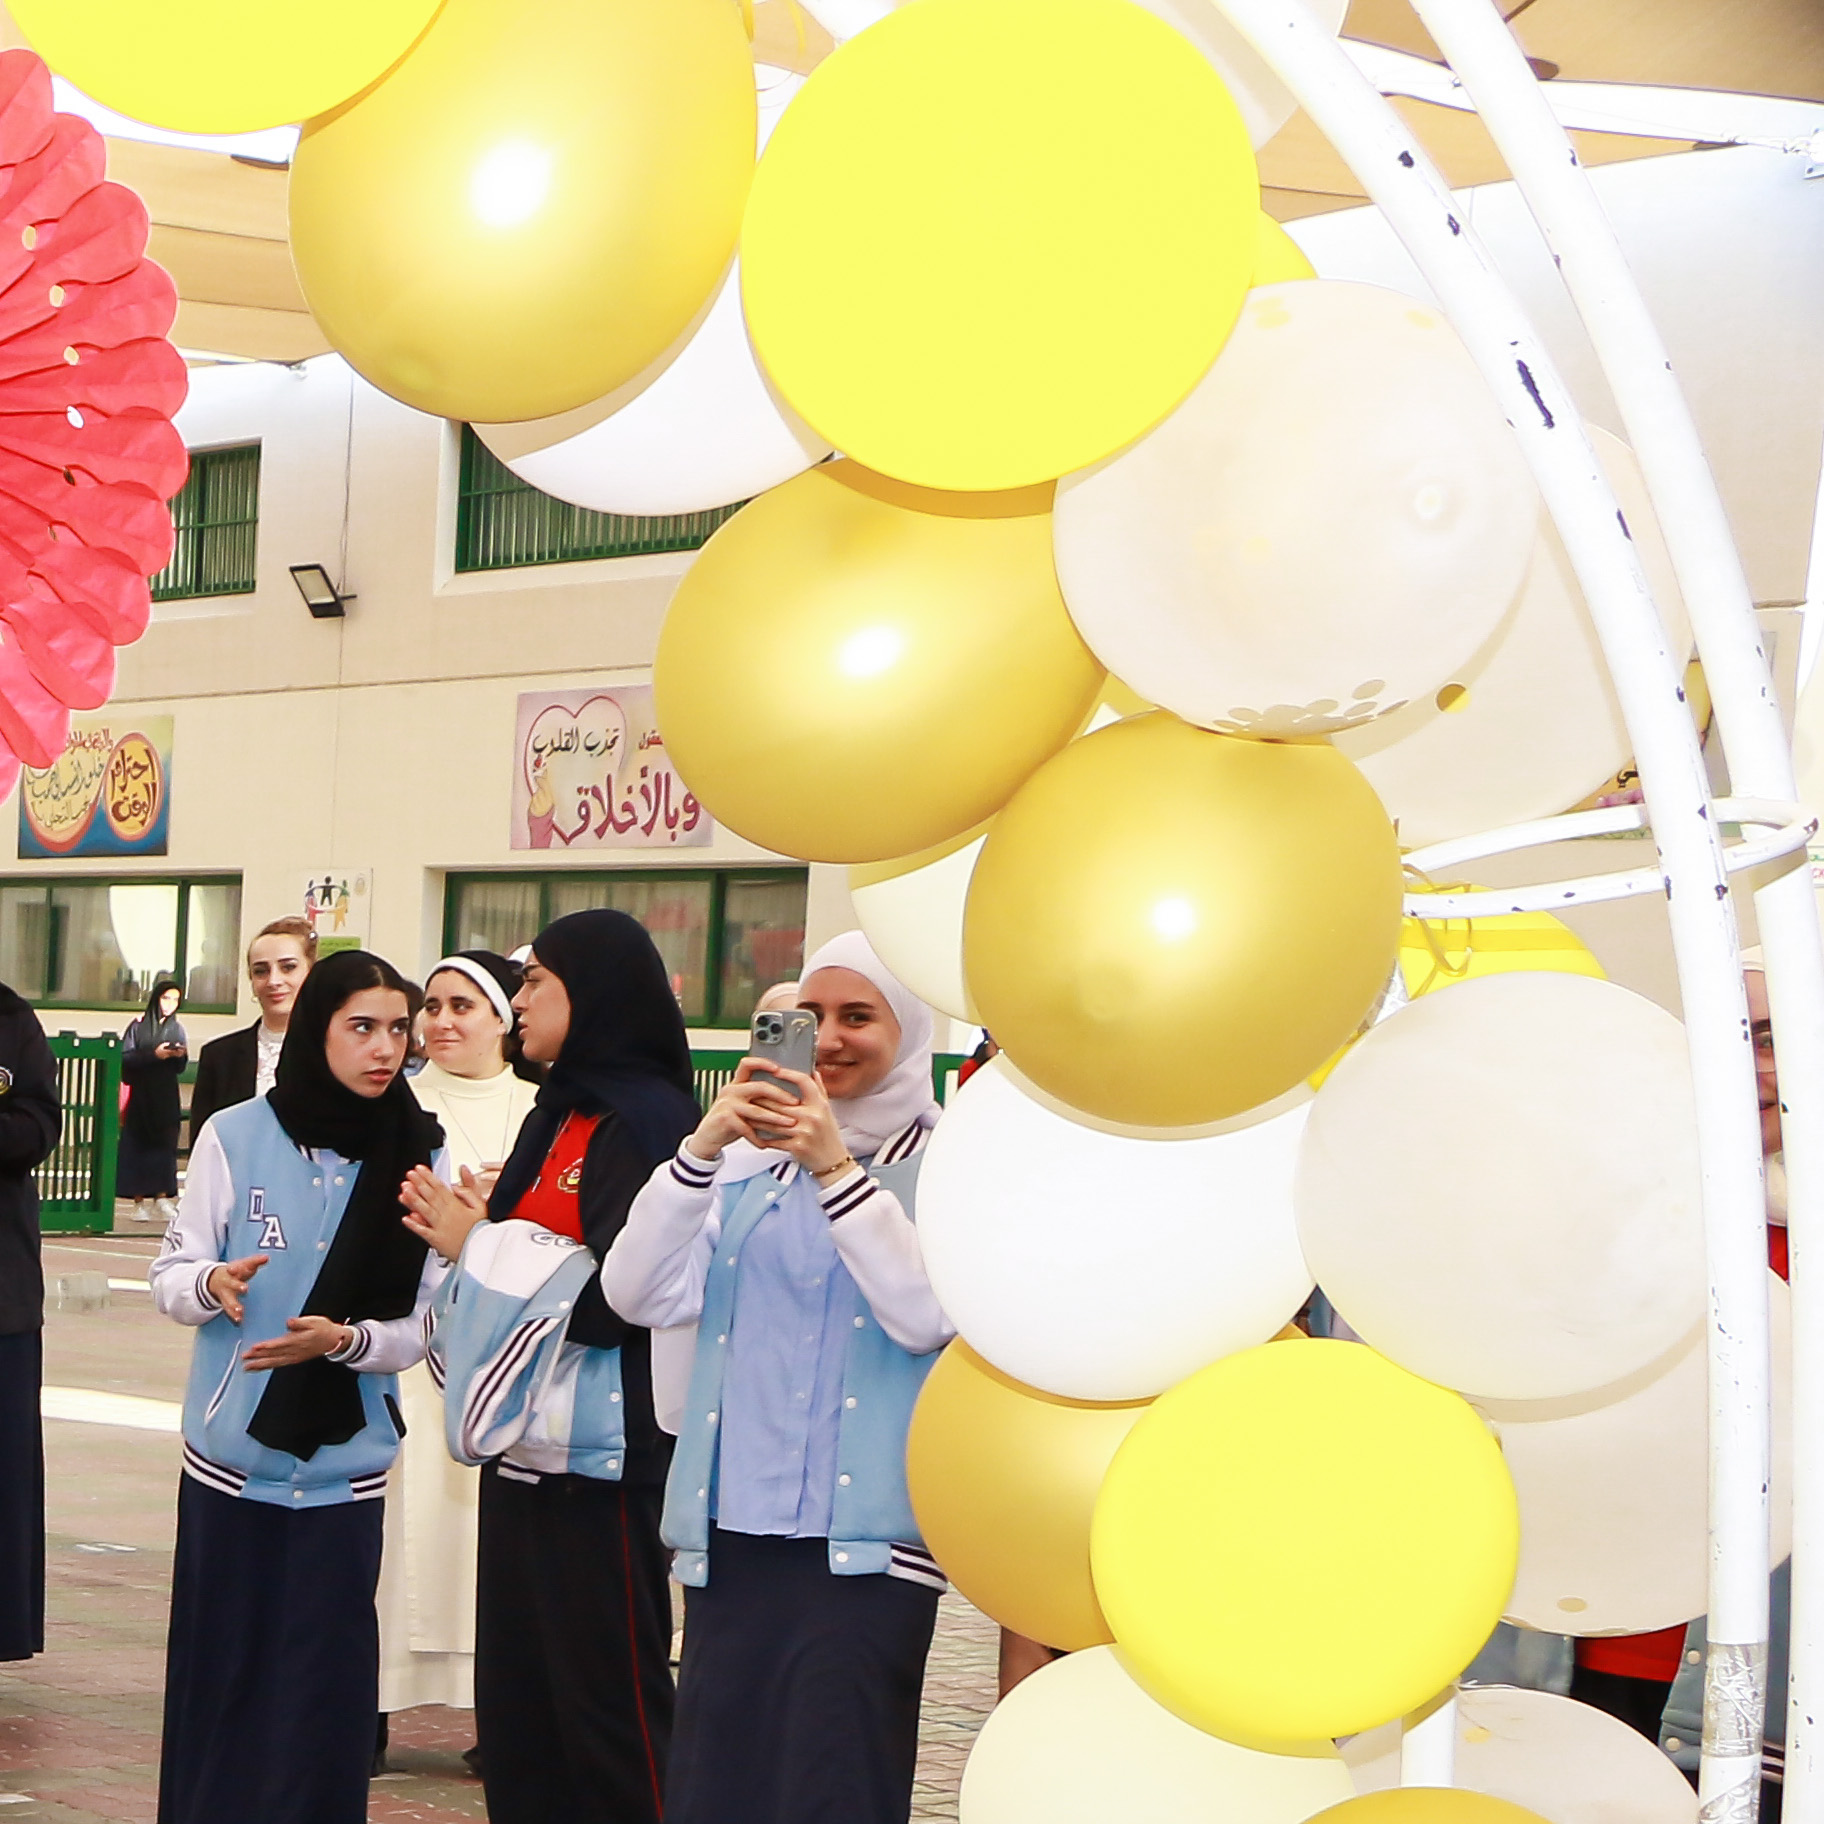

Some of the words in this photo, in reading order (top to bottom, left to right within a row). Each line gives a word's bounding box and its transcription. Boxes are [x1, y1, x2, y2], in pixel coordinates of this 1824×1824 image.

[110, 748, 156, 801] احترام
[110, 781, 157, 827] الوقت
[552, 765, 702, 846] وبالأخلاق
